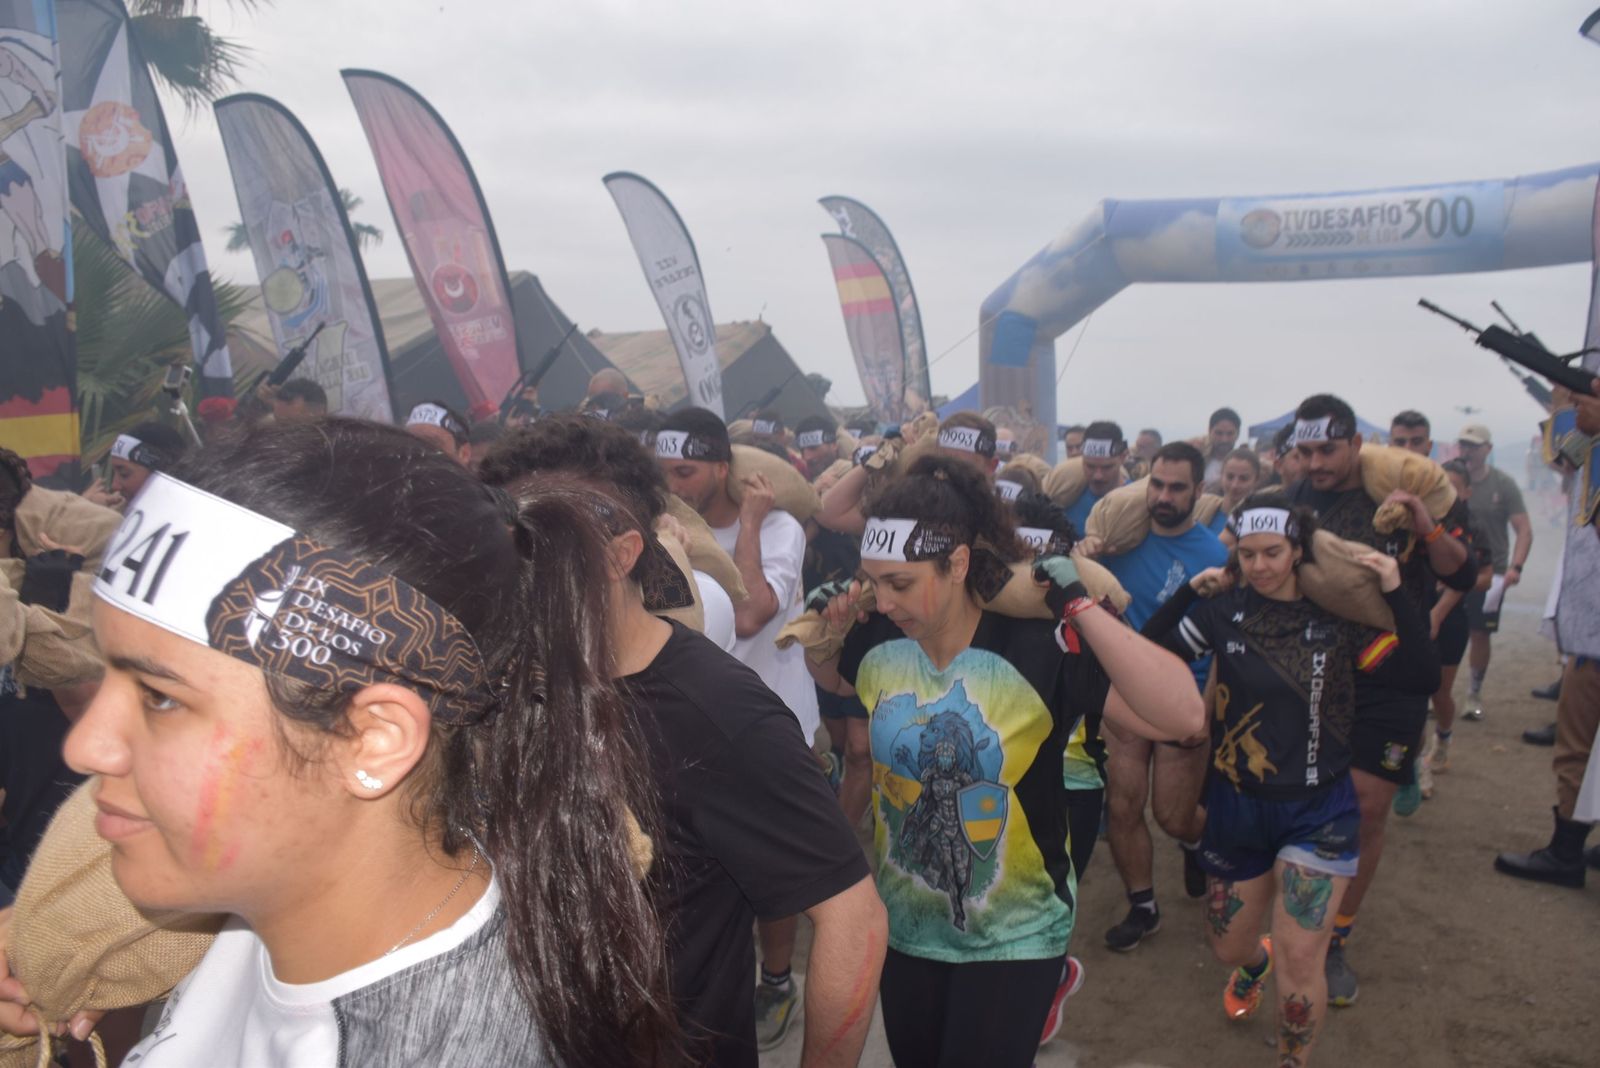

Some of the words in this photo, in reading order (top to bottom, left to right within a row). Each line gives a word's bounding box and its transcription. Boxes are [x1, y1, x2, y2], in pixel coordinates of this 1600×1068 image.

[1401, 196, 1474, 240] 300
[1250, 515, 1278, 532] 1691
[862, 526, 896, 554] 991
[304, 576, 330, 598] IX
[271, 628, 332, 665] 300
[284, 612, 317, 637] DE
[320, 628, 362, 656] LOS
[1313, 652, 1326, 676] IX
